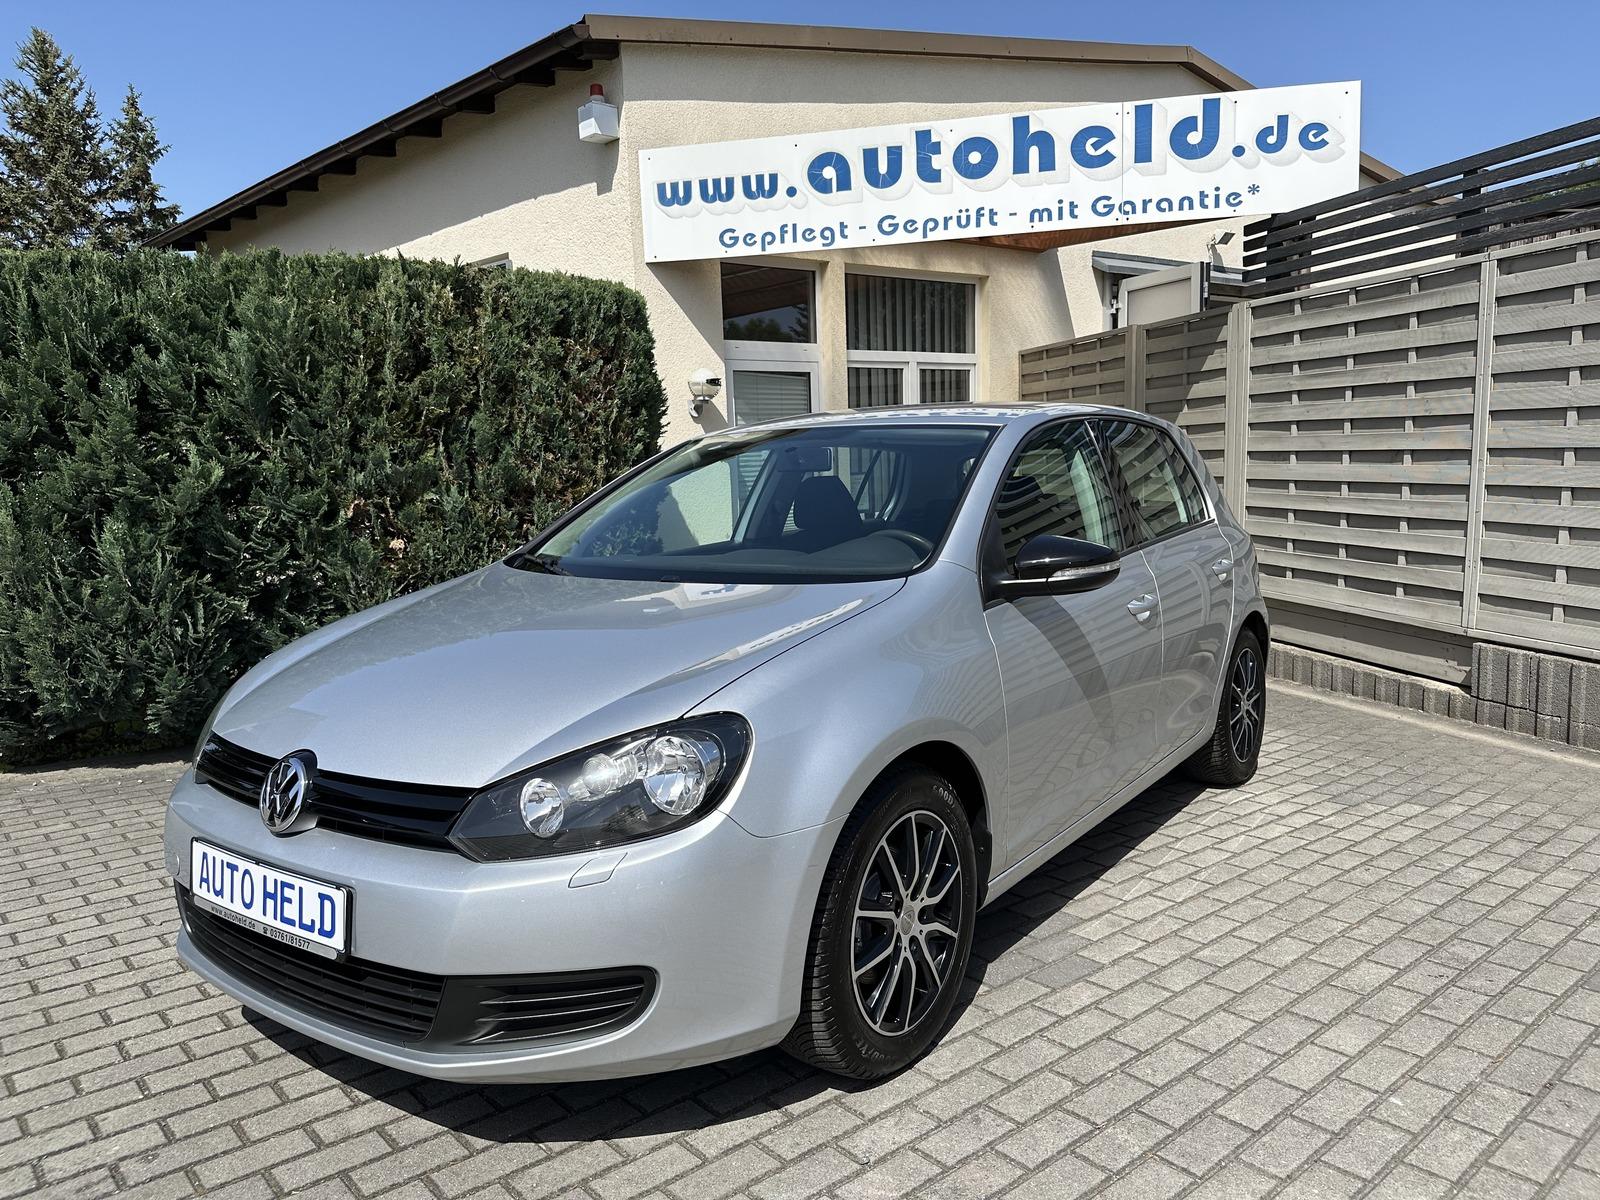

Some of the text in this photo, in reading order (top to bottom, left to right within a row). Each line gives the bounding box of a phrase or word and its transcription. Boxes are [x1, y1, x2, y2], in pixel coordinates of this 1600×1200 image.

[656, 97, 1329, 207] www.autoheld.de
[719, 223, 847, 251] Gepflegt
[876, 207, 998, 239] Geprüft
[1029, 198, 1079, 223] mit
[199, 851, 336, 939] AUTO HELD
[210, 905, 311, 949] www.autoheld.de 03761/81577
